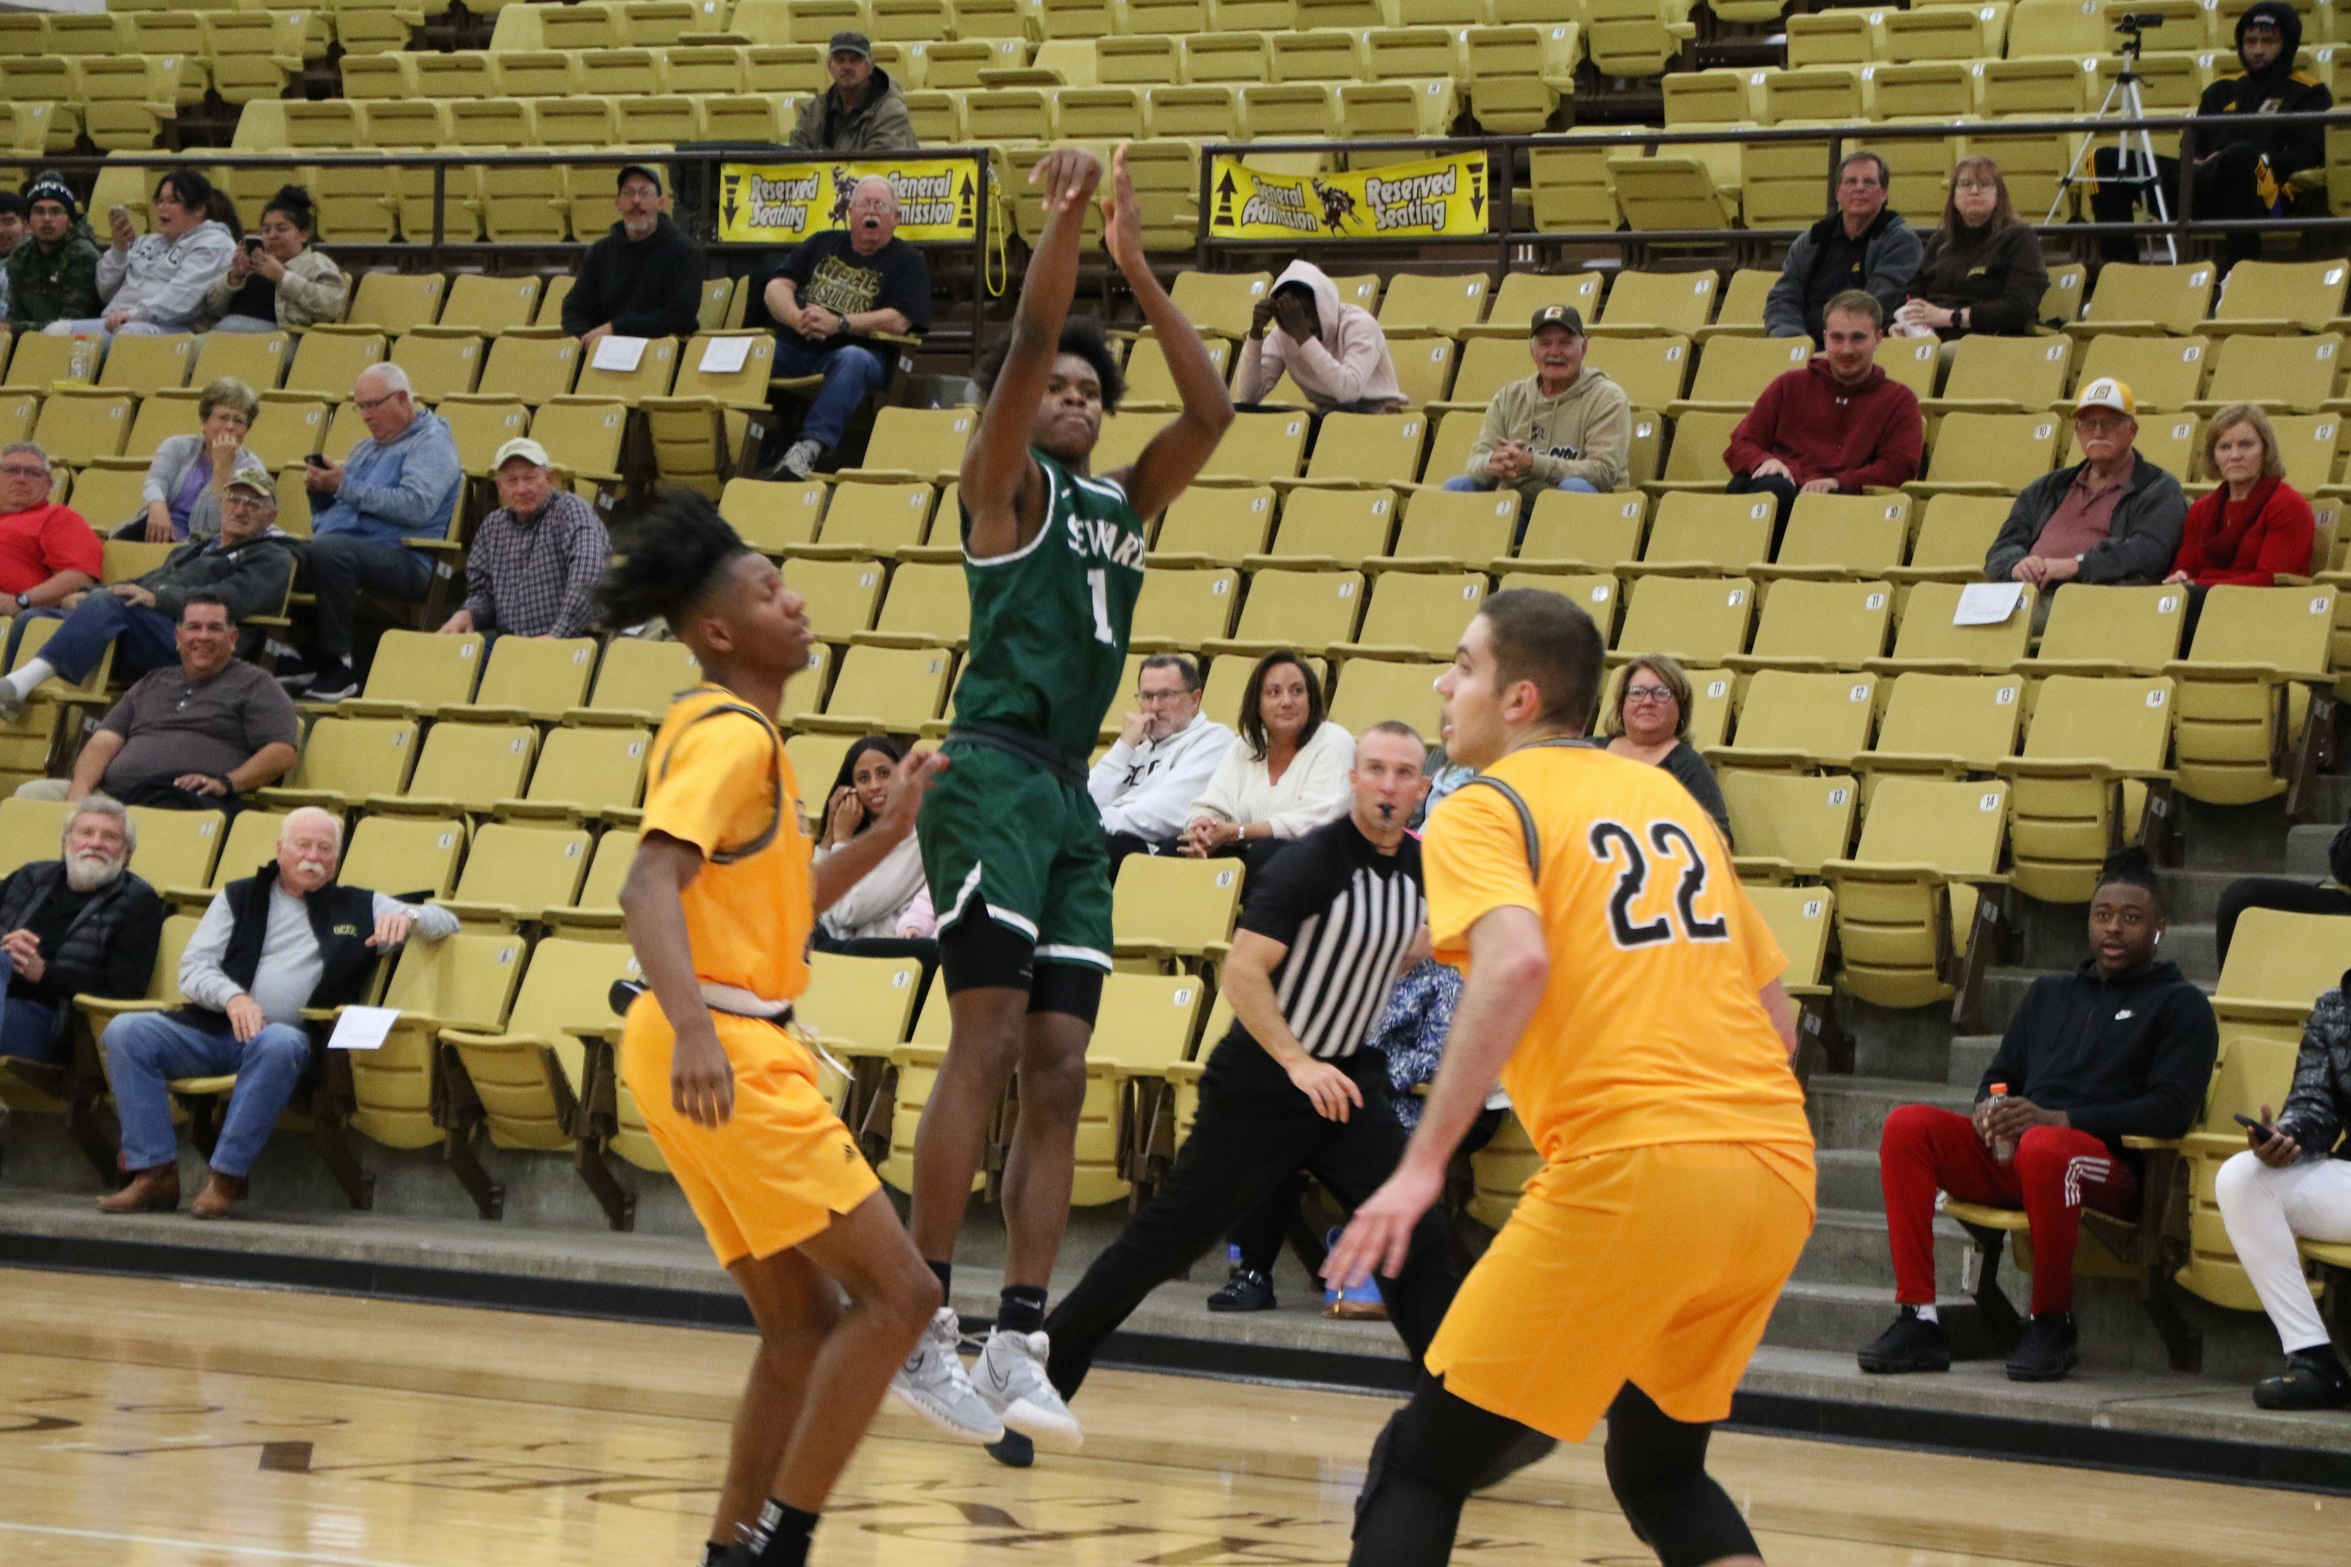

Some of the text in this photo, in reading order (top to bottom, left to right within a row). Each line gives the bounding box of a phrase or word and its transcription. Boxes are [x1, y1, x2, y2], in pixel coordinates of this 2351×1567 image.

[749, 172, 820, 201] Reserved
[1365, 165, 1456, 207] Reserved
[748, 199, 807, 233] Seating
[897, 199, 955, 227] mission
[1241, 195, 1318, 232] Admission
[1373, 199, 1447, 231] Seating
[2187, 349, 2196, 360] 10
[2322, 346, 2329, 357] 11
[2038, 425, 2048, 438] 10
[2178, 426, 2186, 437] 11
[2319, 426, 2329, 439] 12
[1889, 505, 1899, 518] 10
[1087, 568, 1113, 645] 1
[1872, 595, 1880, 607] 11
[2163, 598, 2173, 611] 13
[2316, 598, 2325, 612] 14
[1713, 683, 1722, 695] 11
[1855, 686, 1865, 699] 12
[2001, 689, 2011, 702] 13
[2153, 691, 2162, 704] 14
[1833, 790, 1843, 804] 13
[1986, 795, 1995, 808] 14
[1220, 872, 1230, 885] 10
[1587, 819, 1731, 951] 22
[1808, 902, 1818, 915] 14
[1179, 991, 1188, 1003] 11
